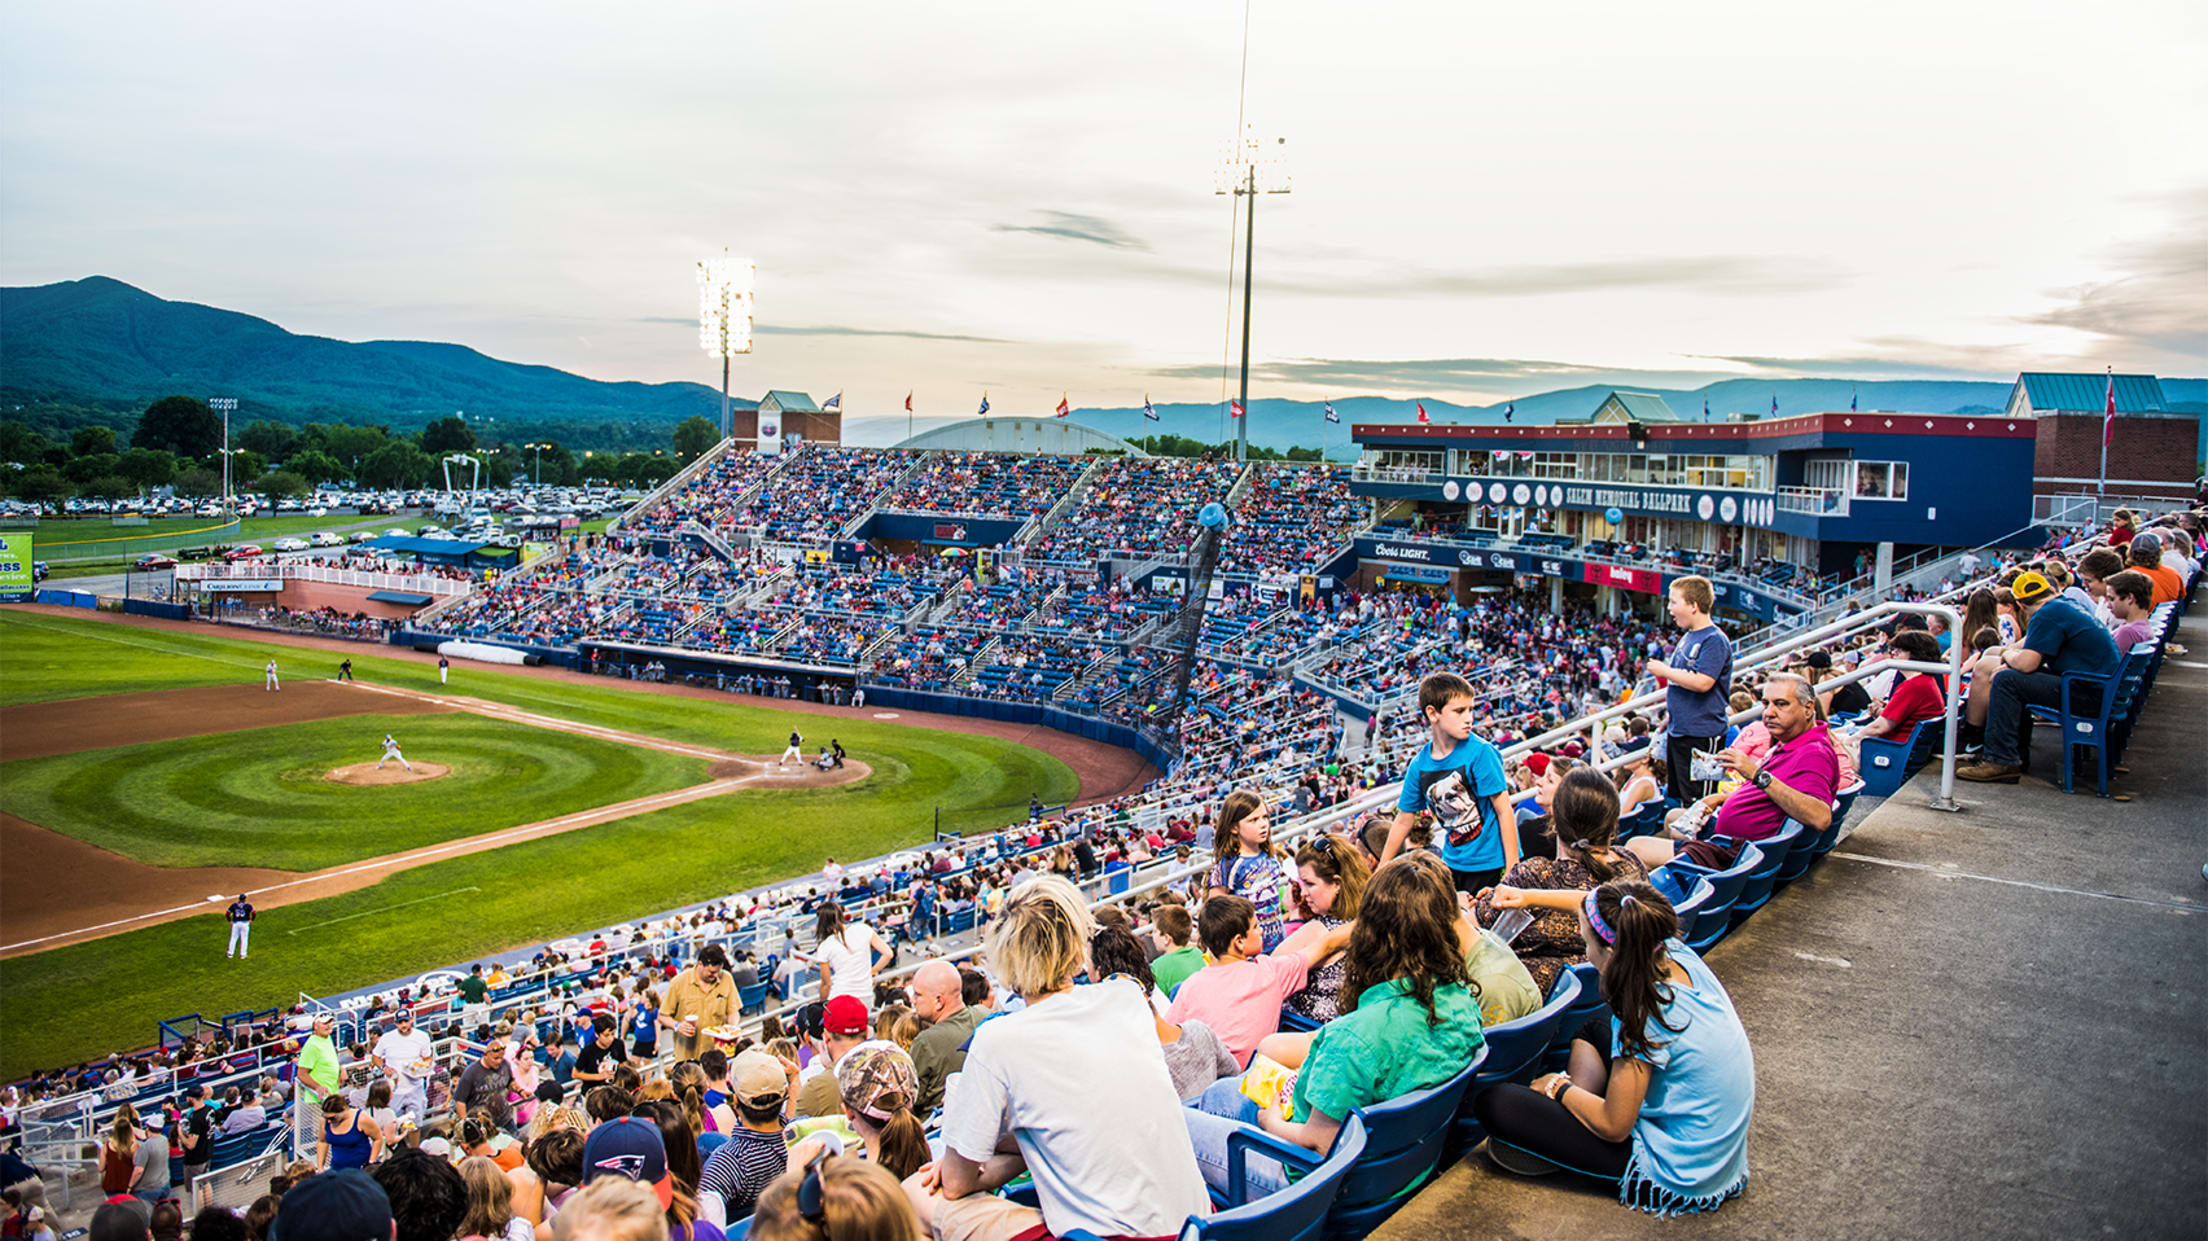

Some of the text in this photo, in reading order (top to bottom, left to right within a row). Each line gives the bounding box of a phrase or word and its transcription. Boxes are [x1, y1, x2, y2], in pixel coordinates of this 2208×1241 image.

[1566, 487, 1692, 513] SALEM MEMORIAL BALLPARK
[1375, 543, 1430, 561] Coors LIGHT
